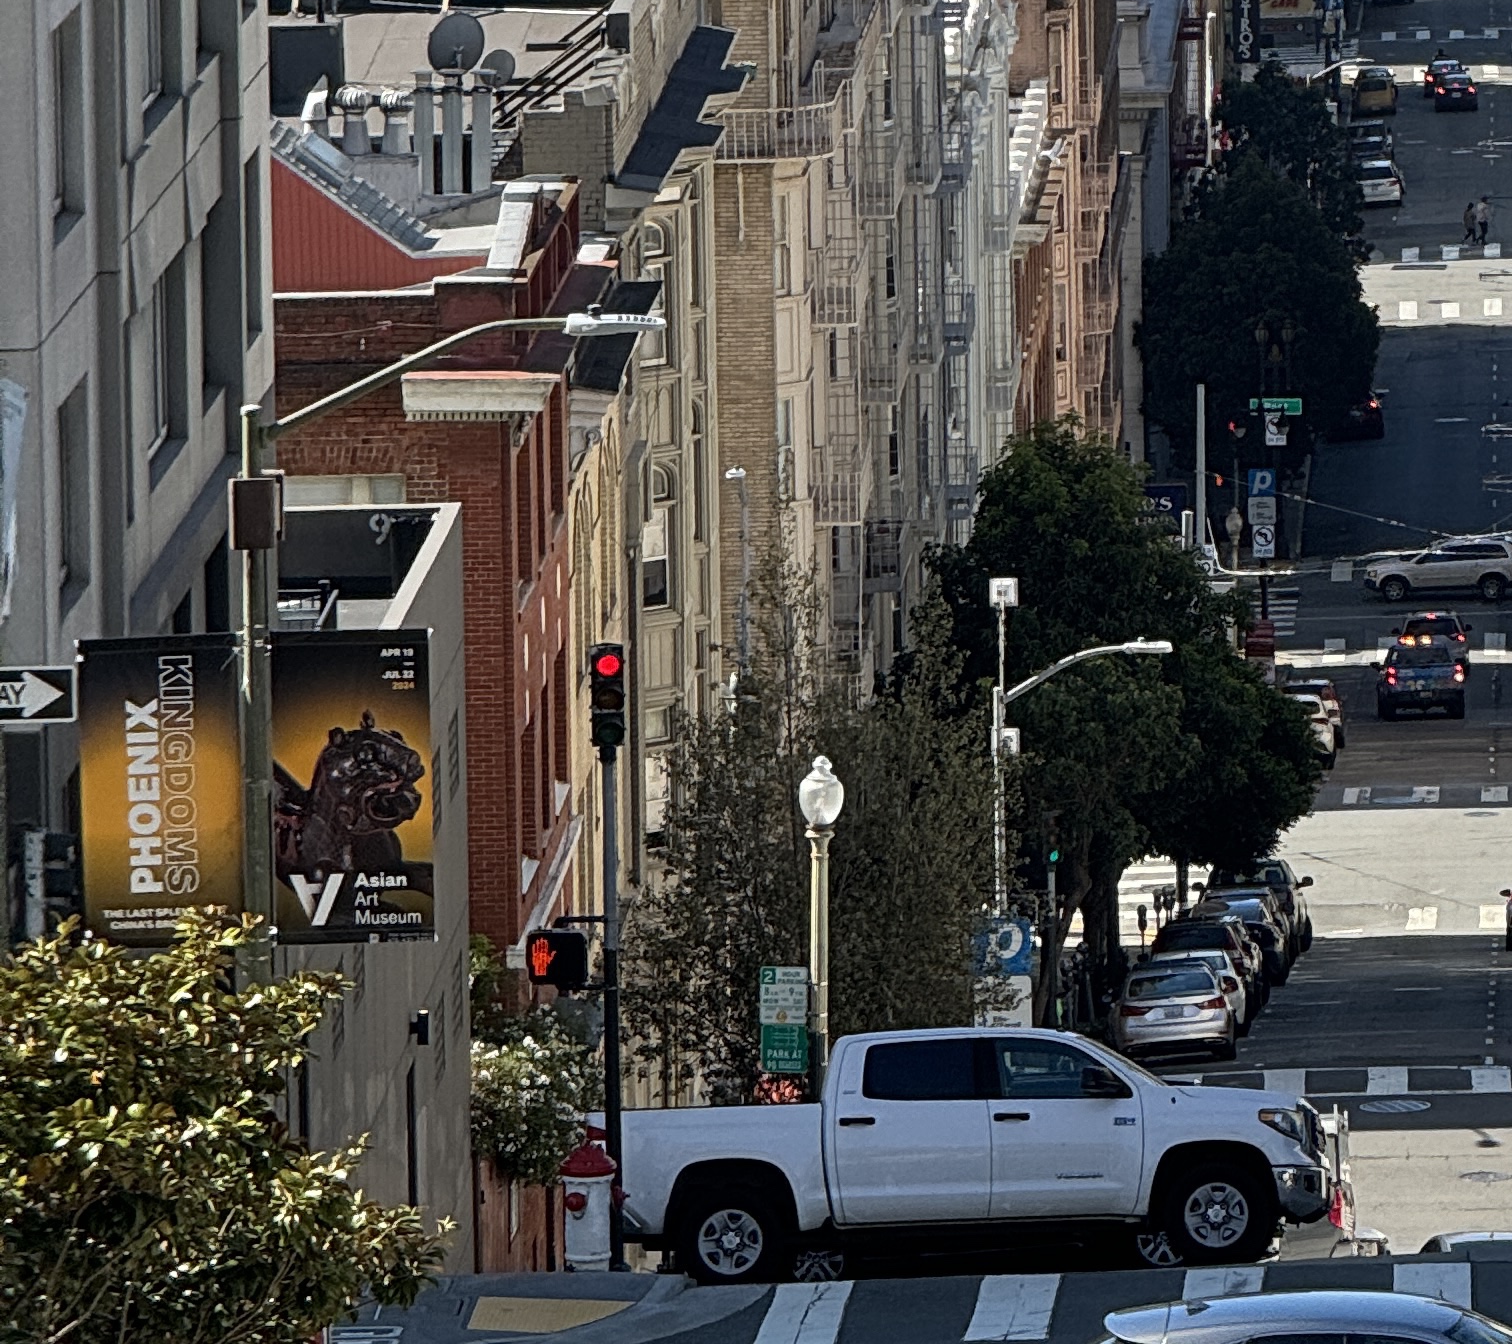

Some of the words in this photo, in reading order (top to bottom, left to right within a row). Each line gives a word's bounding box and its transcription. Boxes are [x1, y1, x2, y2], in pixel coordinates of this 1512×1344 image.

[380, 648, 401, 657] APR
[381, 671, 401, 679] JUL
[0, 684, 27, 705] AY
[158, 655, 200, 895] KINGDOMS
[125, 698, 164, 894] PHOENIX
[354, 872, 407, 888] Asian
[354, 891, 379, 906] Art
[355, 910, 421, 925] Museum
[763, 970, 774, 983] 2
[767, 1049, 789, 1059] PARK
